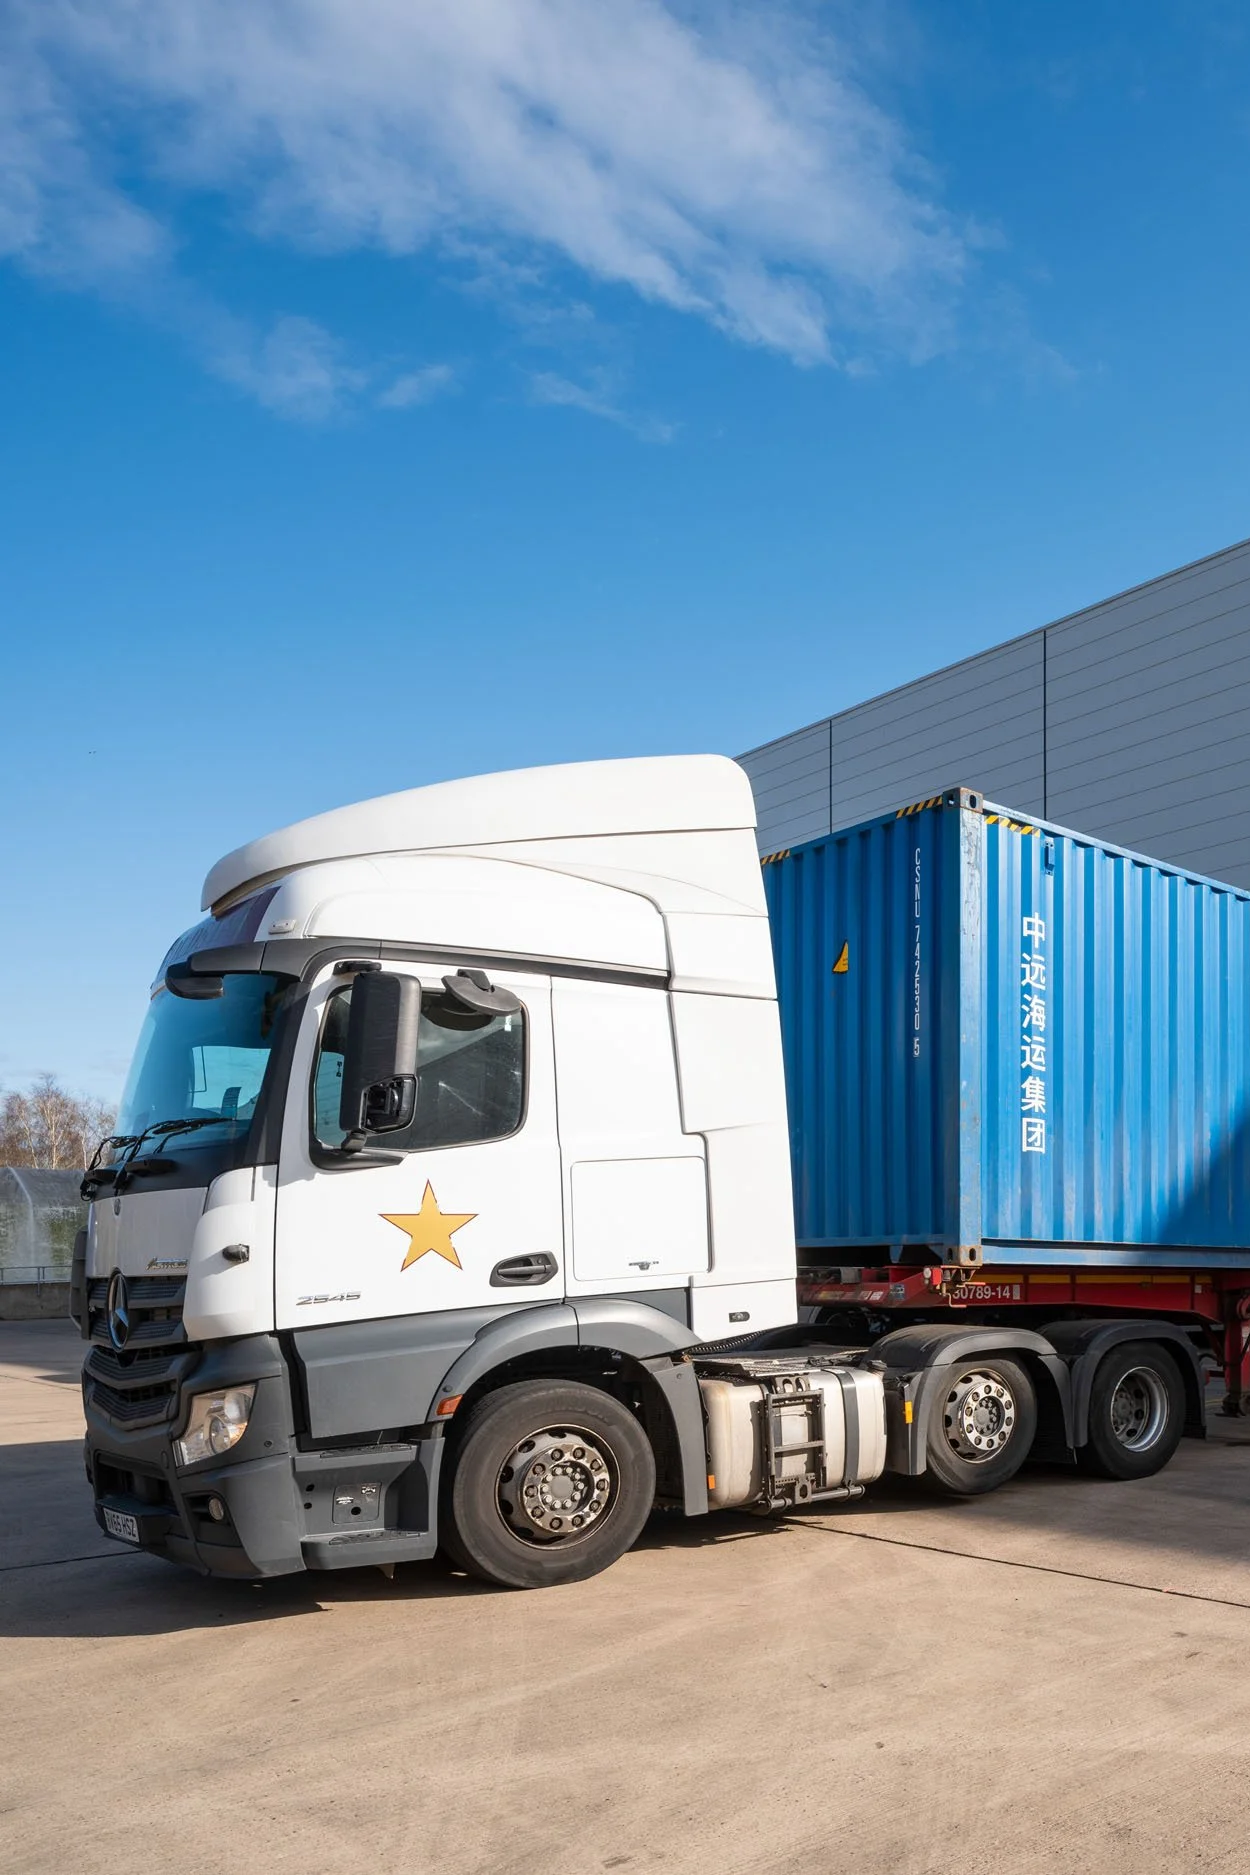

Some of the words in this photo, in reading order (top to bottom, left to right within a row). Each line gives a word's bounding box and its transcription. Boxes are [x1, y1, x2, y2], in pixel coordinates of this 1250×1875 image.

[1020, 911, 1046, 1154] 中远海运集团
[913, 1037, 921, 1056] 5
[295, 1291, 361, 1306] 2545
